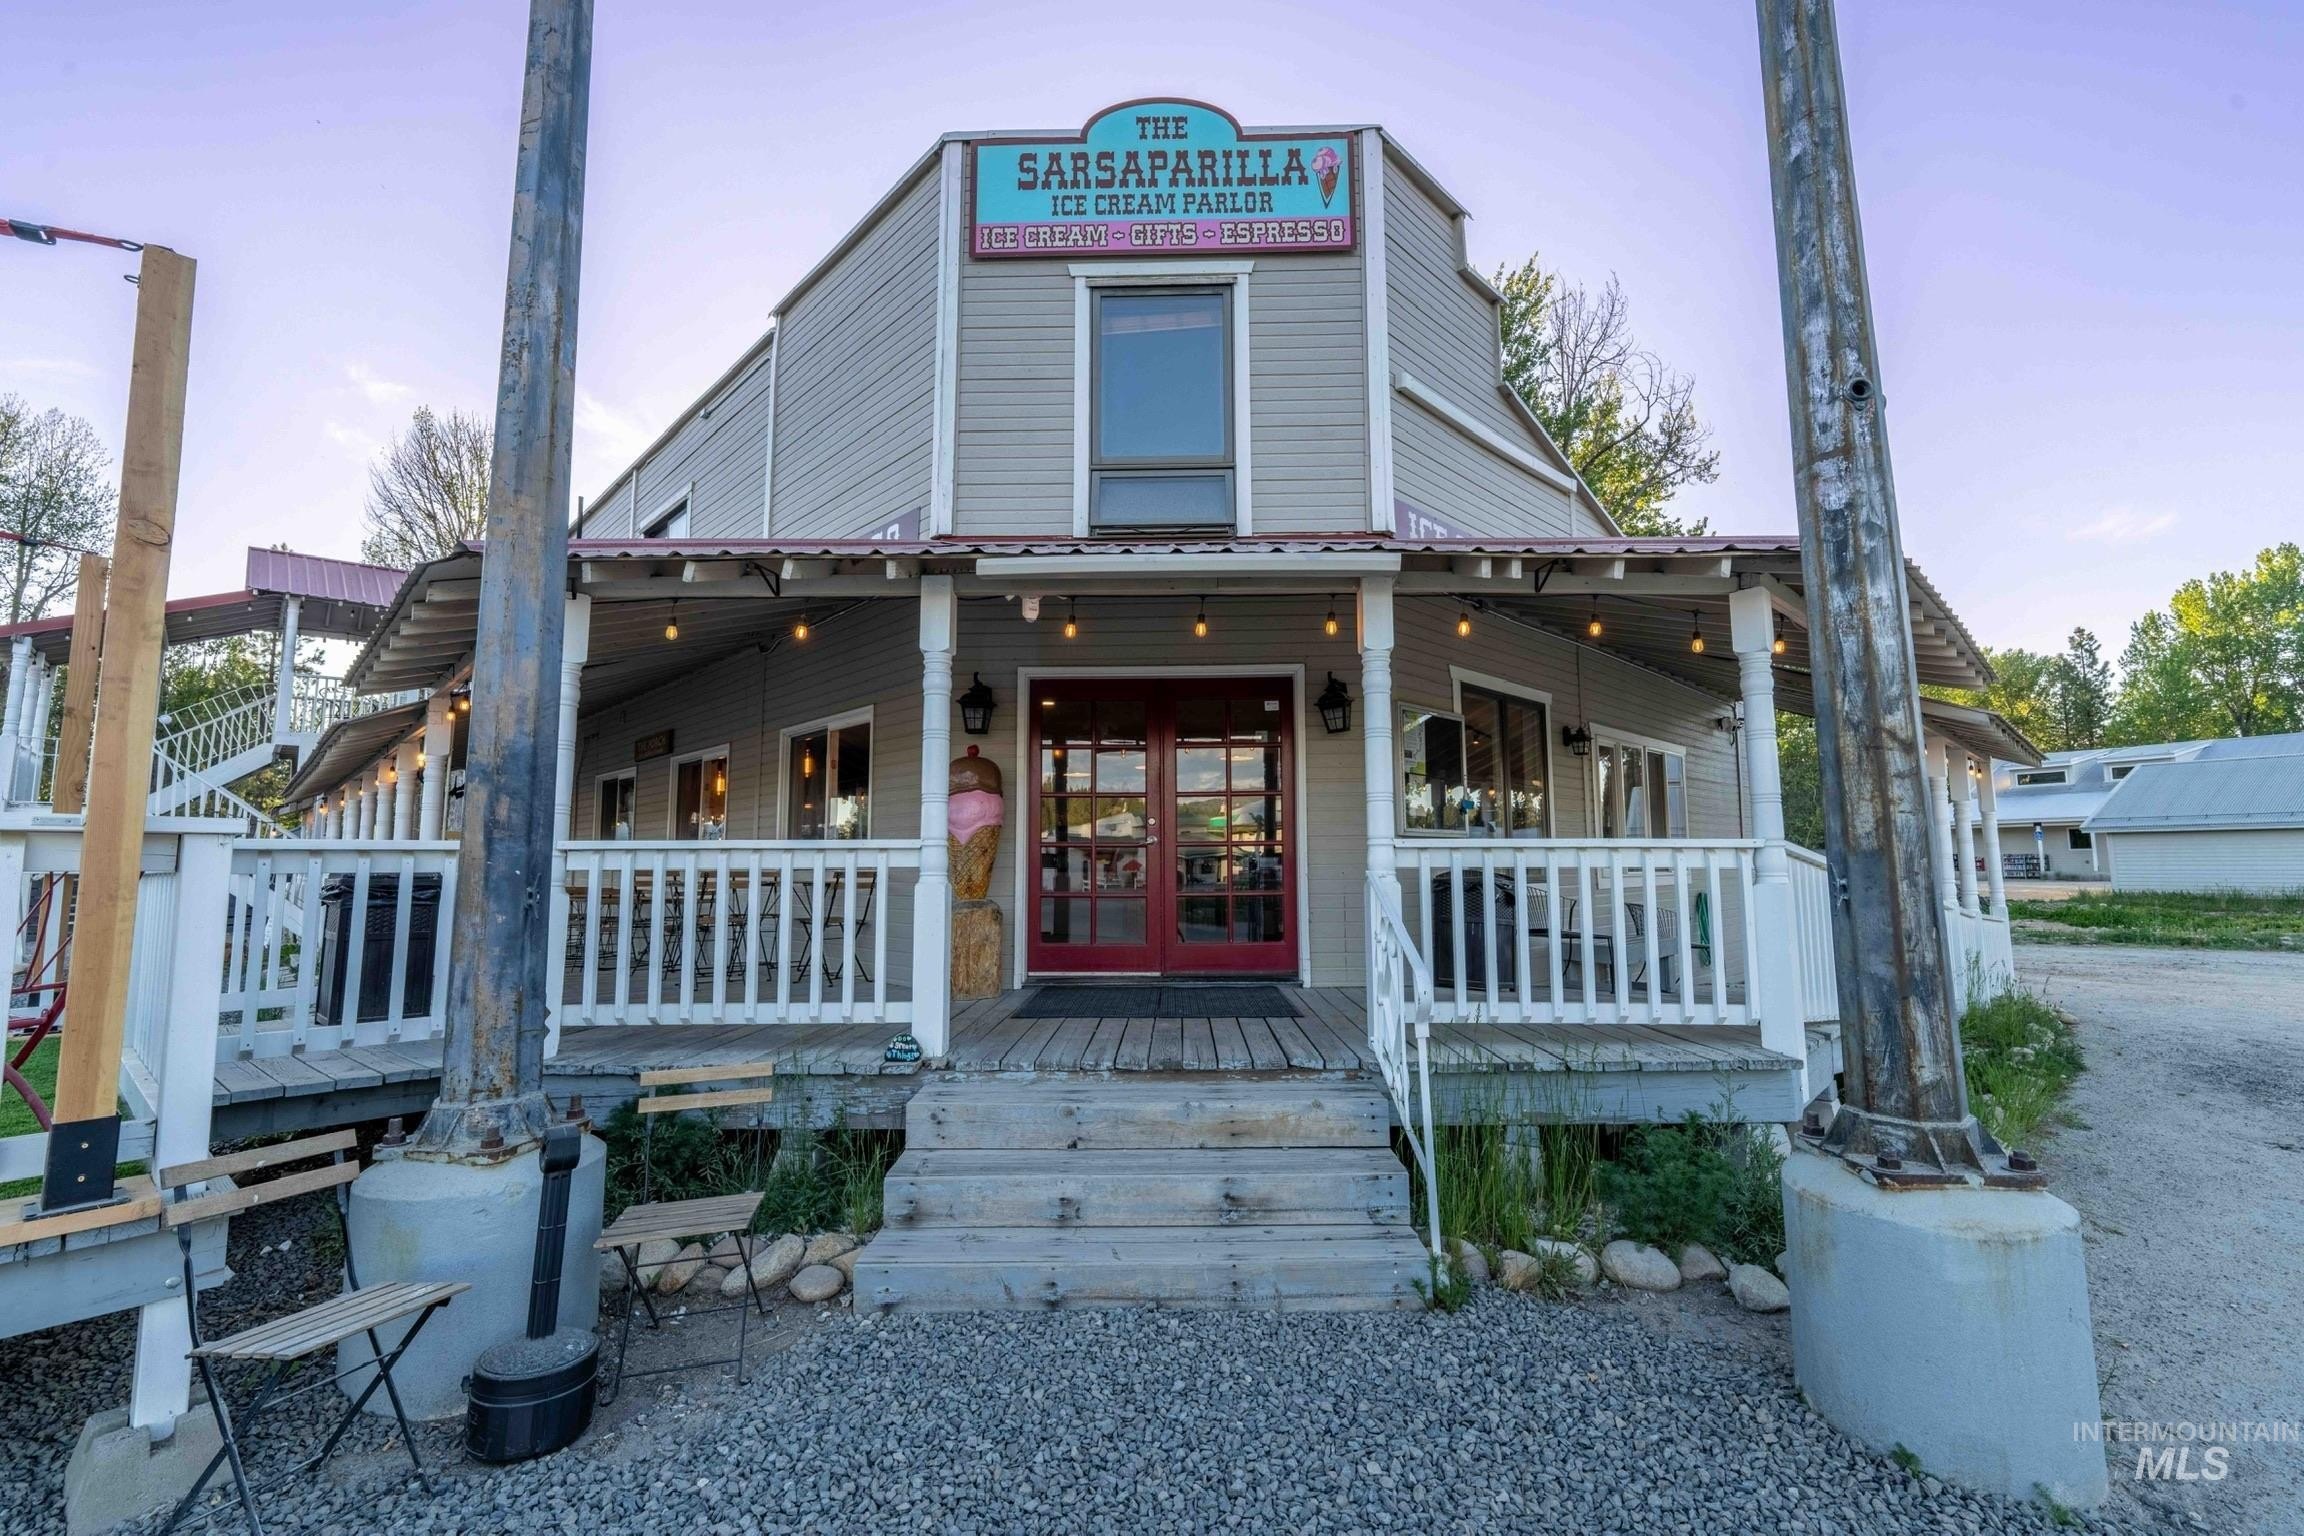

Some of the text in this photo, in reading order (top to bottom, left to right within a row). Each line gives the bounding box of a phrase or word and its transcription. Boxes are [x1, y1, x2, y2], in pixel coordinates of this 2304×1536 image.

[1136, 116, 1188, 140] THE
[1017, 148, 1309, 191] SARSAPARILLA
[1051, 191, 1274, 217] ICE CREAM PARLOR
[980, 226, 1019, 250] ICE
[1023, 223, 1108, 248] CREAM
[1129, 221, 1199, 247] GIFTS
[1220, 219, 1346, 245] ESPRESSO
